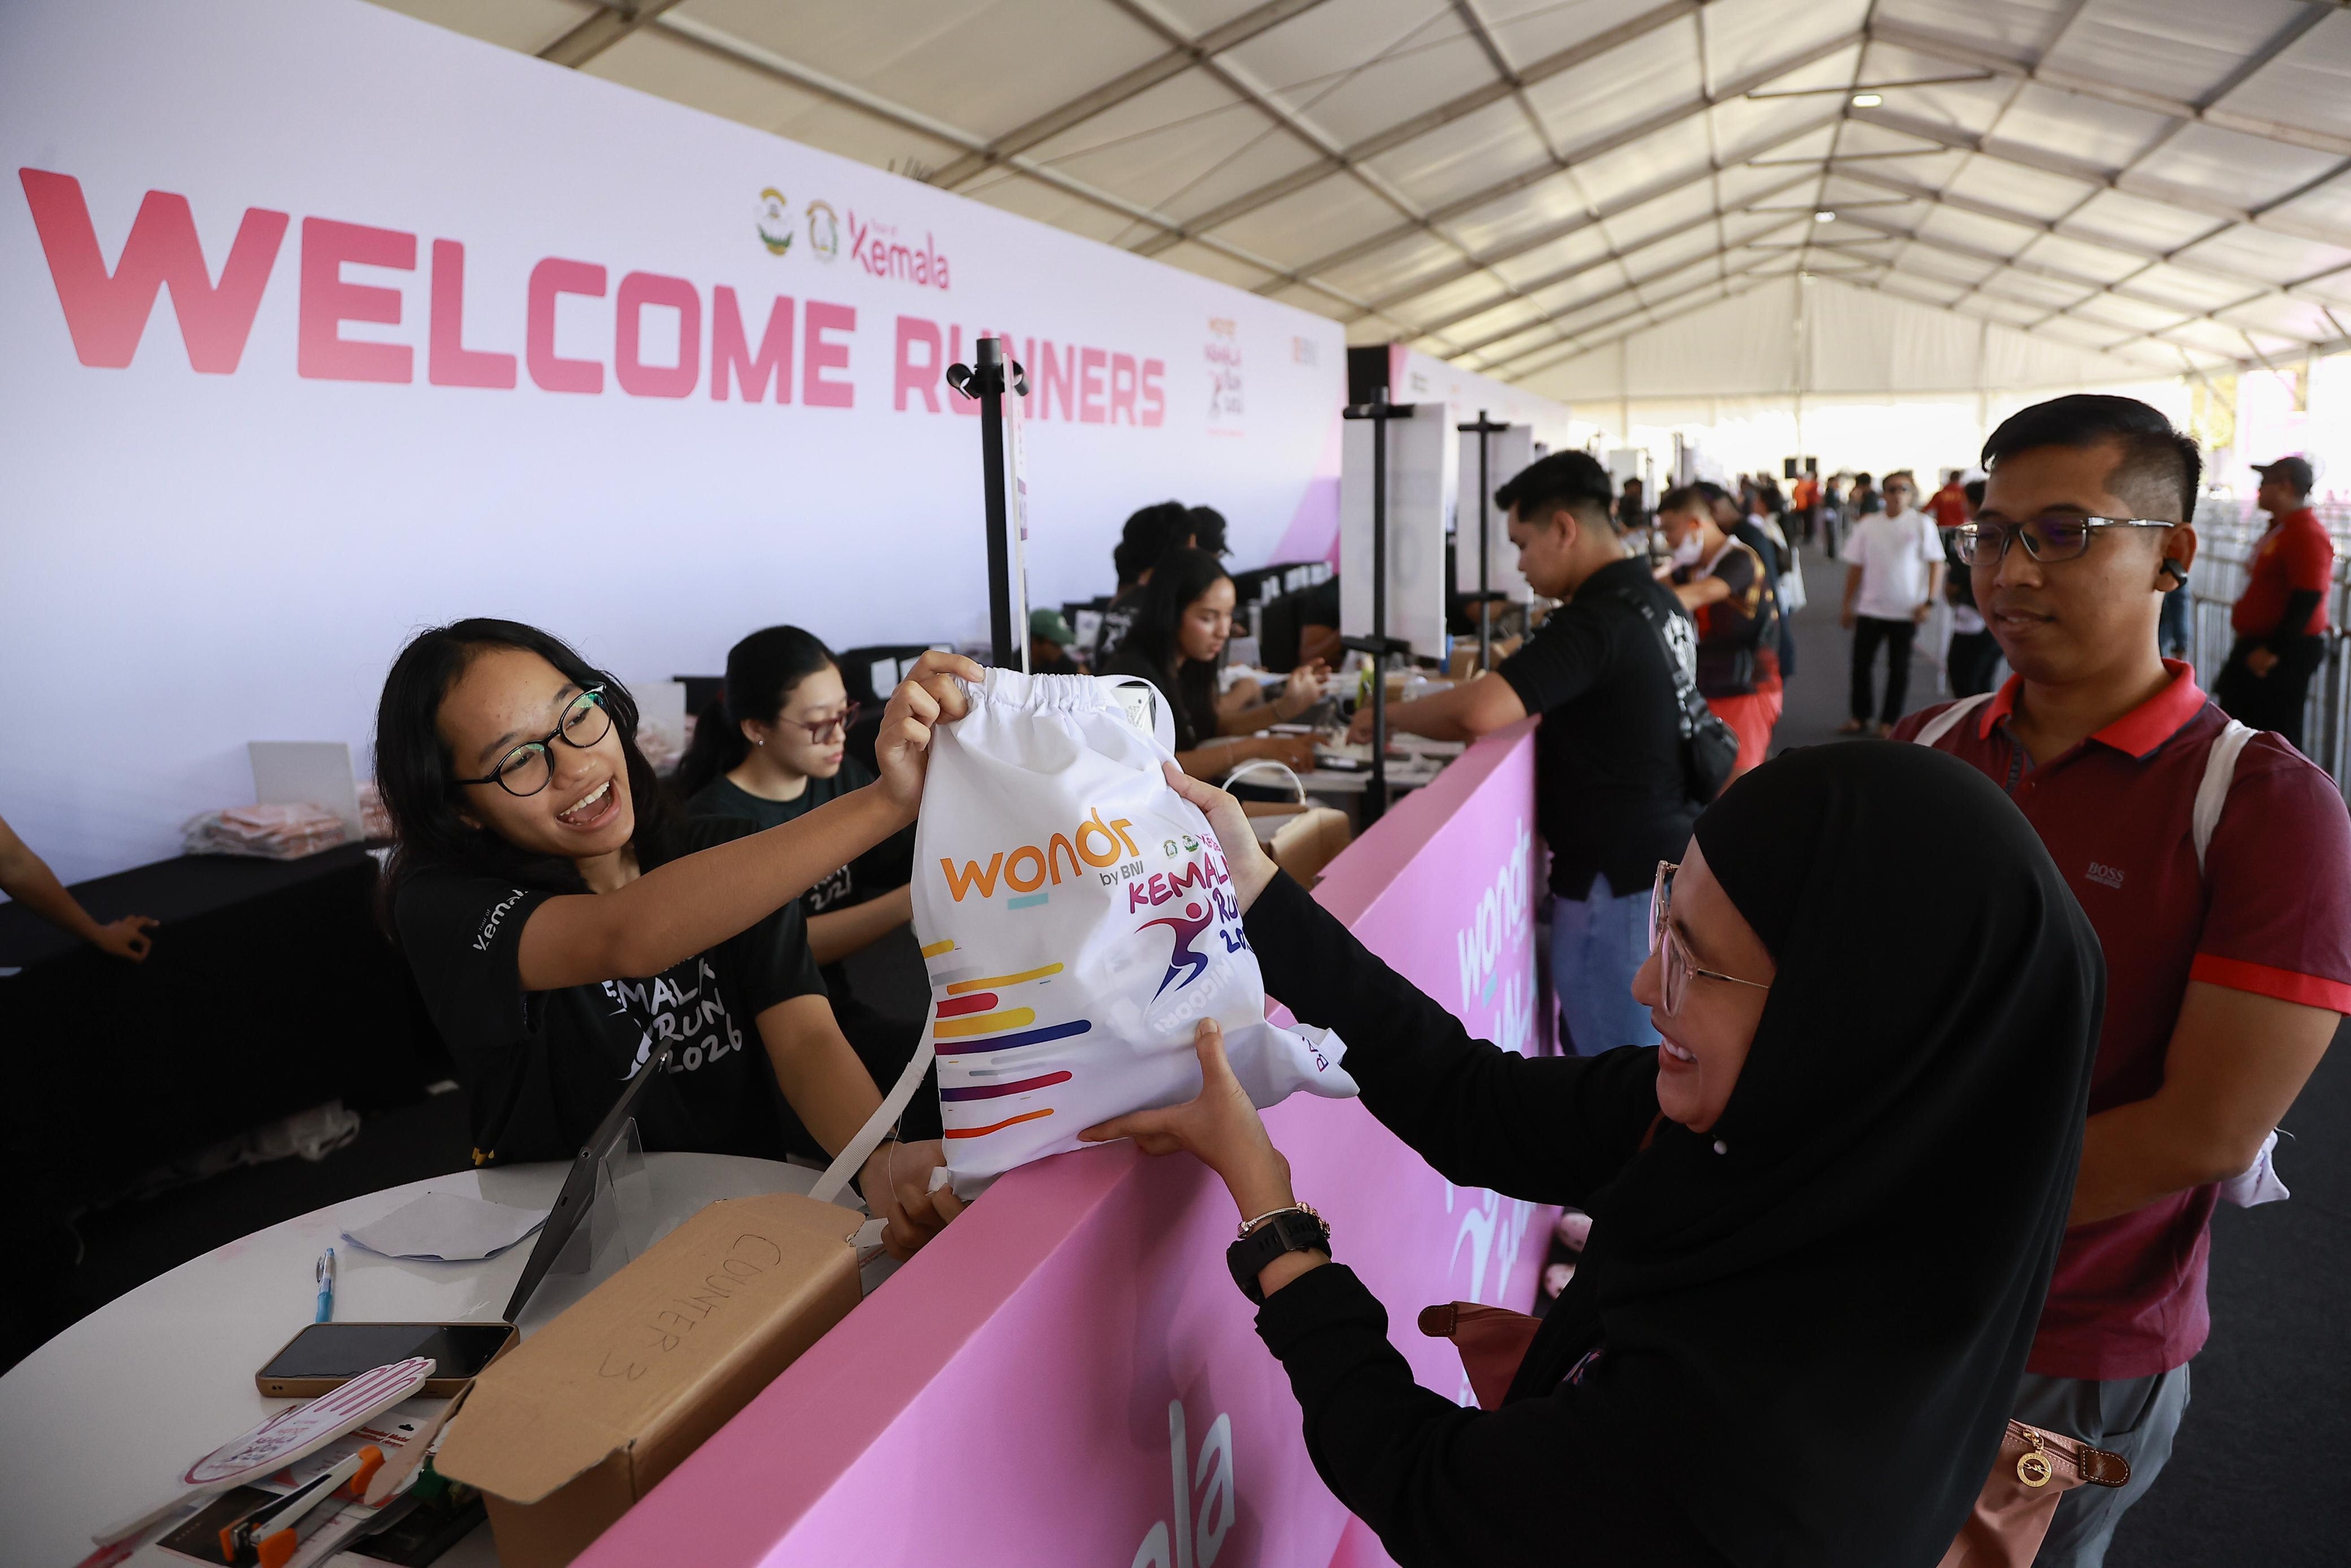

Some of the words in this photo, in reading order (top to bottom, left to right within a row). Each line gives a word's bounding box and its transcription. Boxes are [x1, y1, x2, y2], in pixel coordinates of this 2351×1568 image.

[847, 209, 949, 290] Kemala
[19, 167, 857, 409] WELCOME
[940, 807, 1139, 902] wondr
[1100, 871, 1119, 886] by
[1120, 860, 1144, 879] BNI
[2088, 861, 2124, 882] BOSS
[653, 987, 725, 1041] RUN
[664, 1013, 743, 1074] 2026
[643, 1234, 781, 1352] COUNTER
[598, 1352, 648, 1381] 3
